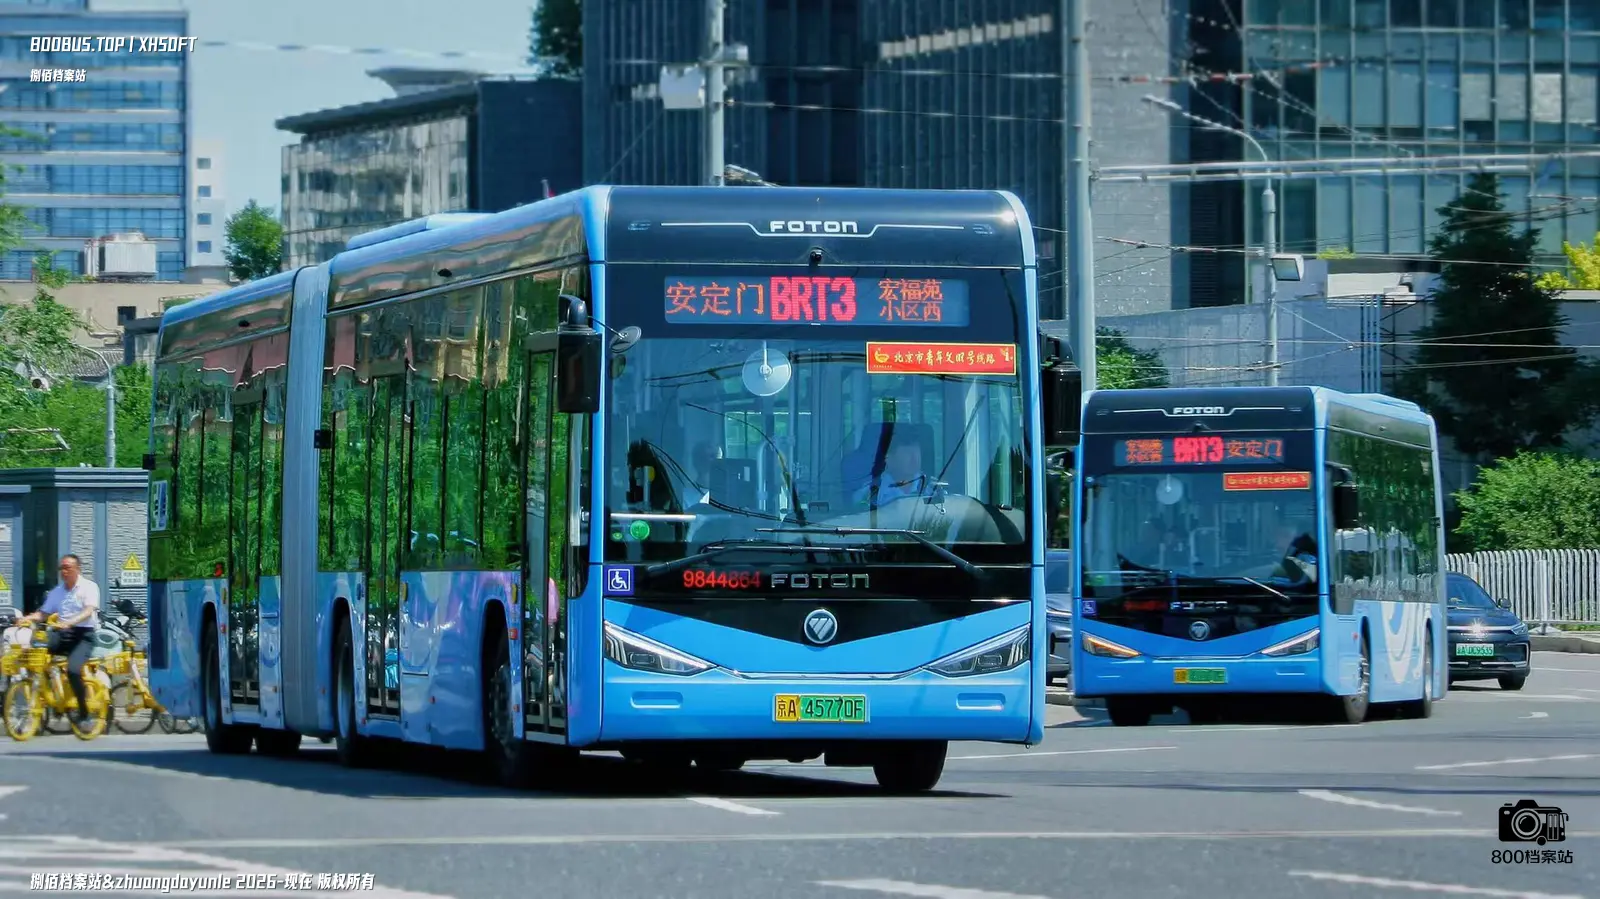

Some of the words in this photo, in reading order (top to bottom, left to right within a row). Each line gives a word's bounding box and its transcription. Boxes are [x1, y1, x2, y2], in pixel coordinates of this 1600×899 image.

[769, 220, 859, 234] FOTON
[665, 282, 764, 316] 安定门
[769, 276, 857, 322] BRT3
[878, 279, 943, 301] 宏福苑
[879, 301, 942, 322] 小区西
[1173, 406, 1225, 415] FOTON
[683, 570, 762, 589] 9844864
[771, 573, 870, 588] FOTON
